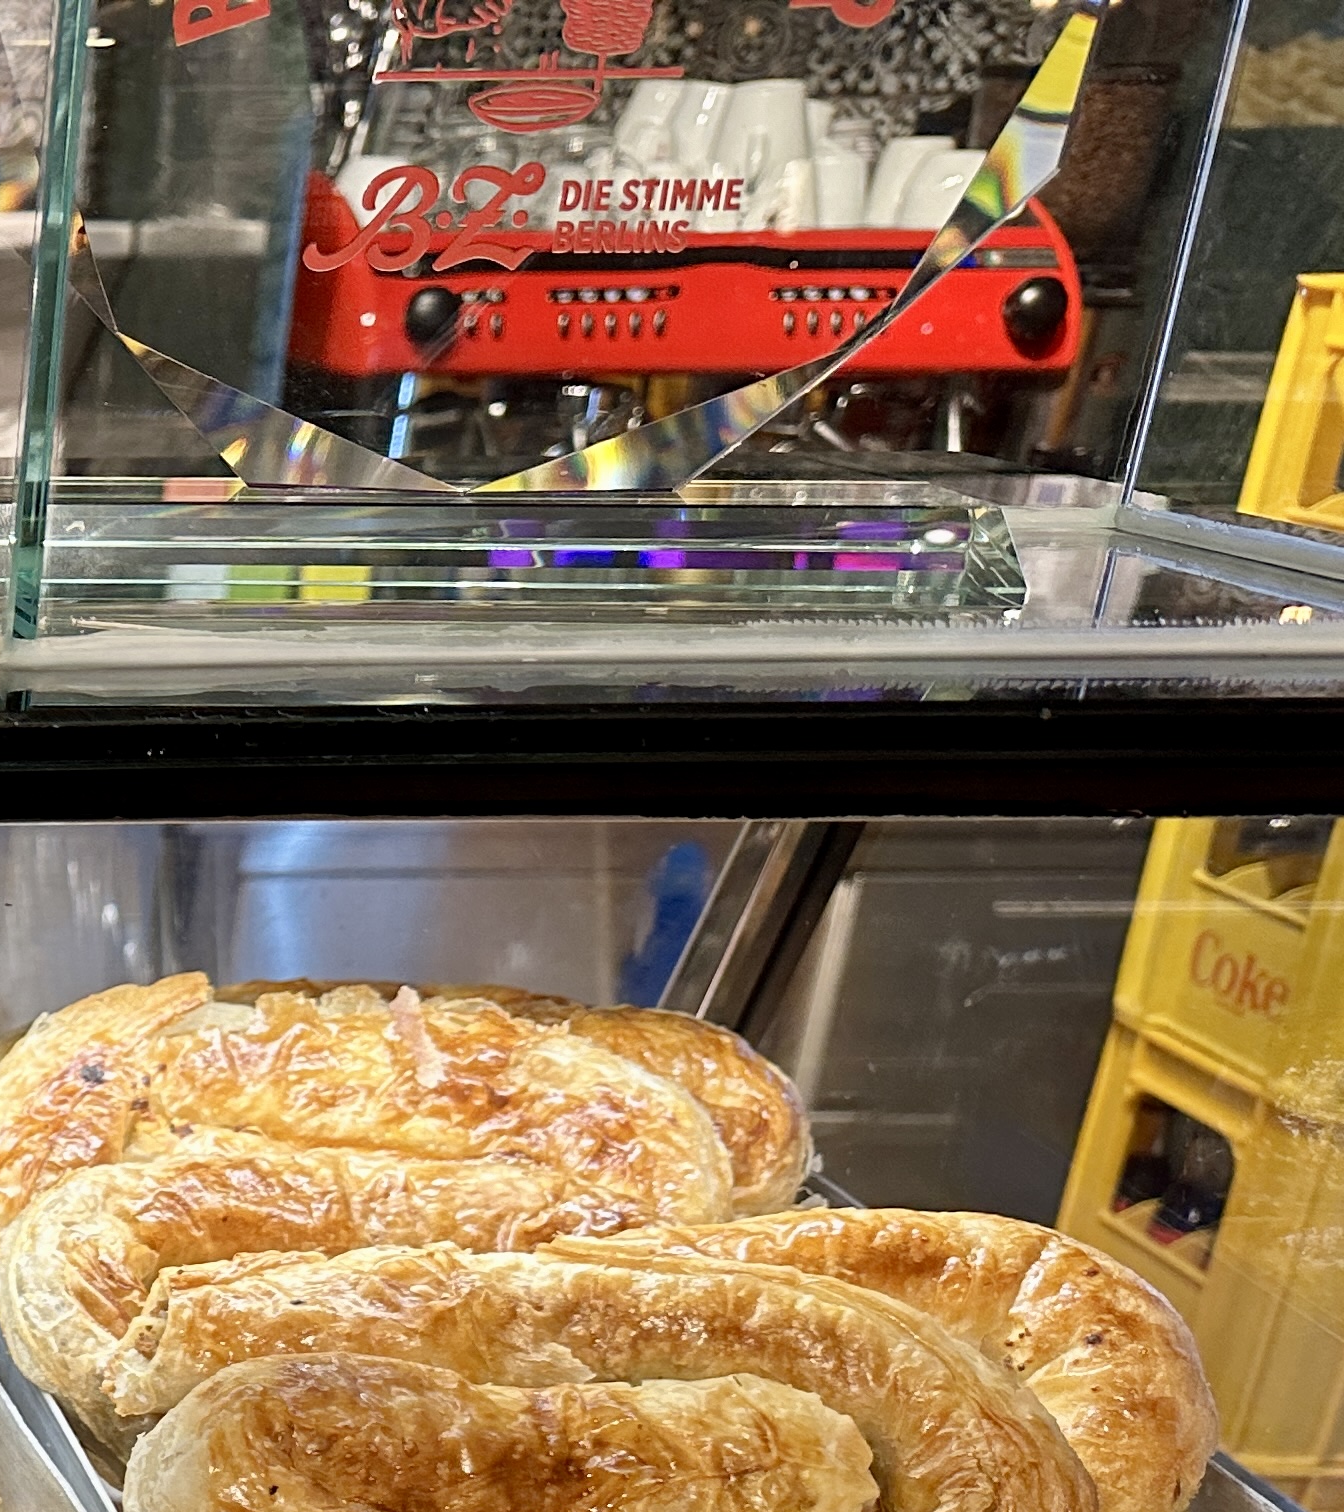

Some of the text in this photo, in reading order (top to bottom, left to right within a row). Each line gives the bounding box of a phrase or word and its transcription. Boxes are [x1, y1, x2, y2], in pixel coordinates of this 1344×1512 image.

[559, 178, 744, 212] DIE STIMME
[552, 219, 689, 254] BERLINS
[1190, 929, 1291, 1019] Coke
